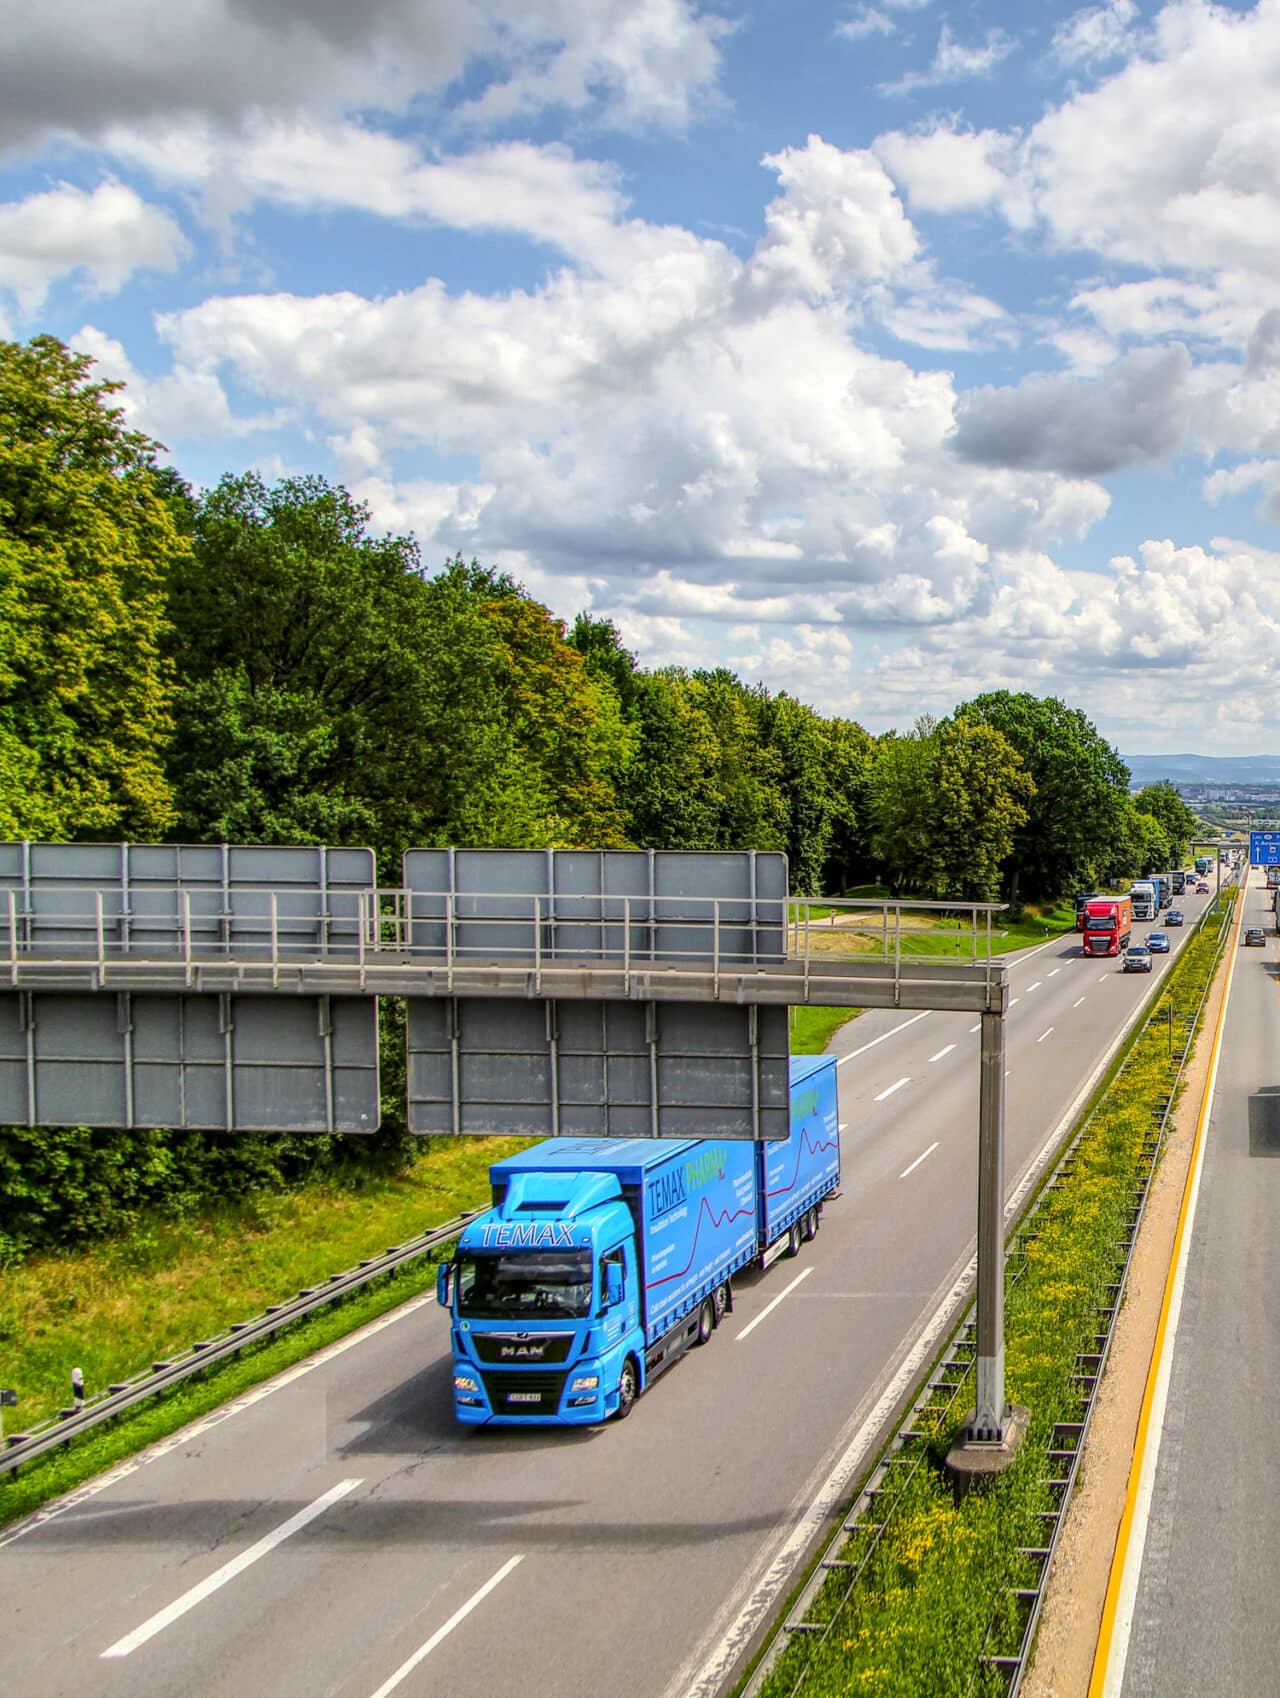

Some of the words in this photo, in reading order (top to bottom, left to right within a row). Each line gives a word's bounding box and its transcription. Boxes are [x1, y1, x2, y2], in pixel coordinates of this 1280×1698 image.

[648, 1166, 686, 1217] TEMAX
[480, 1223, 577, 1247] TEMAX
[501, 1346, 545, 1357] MAN
